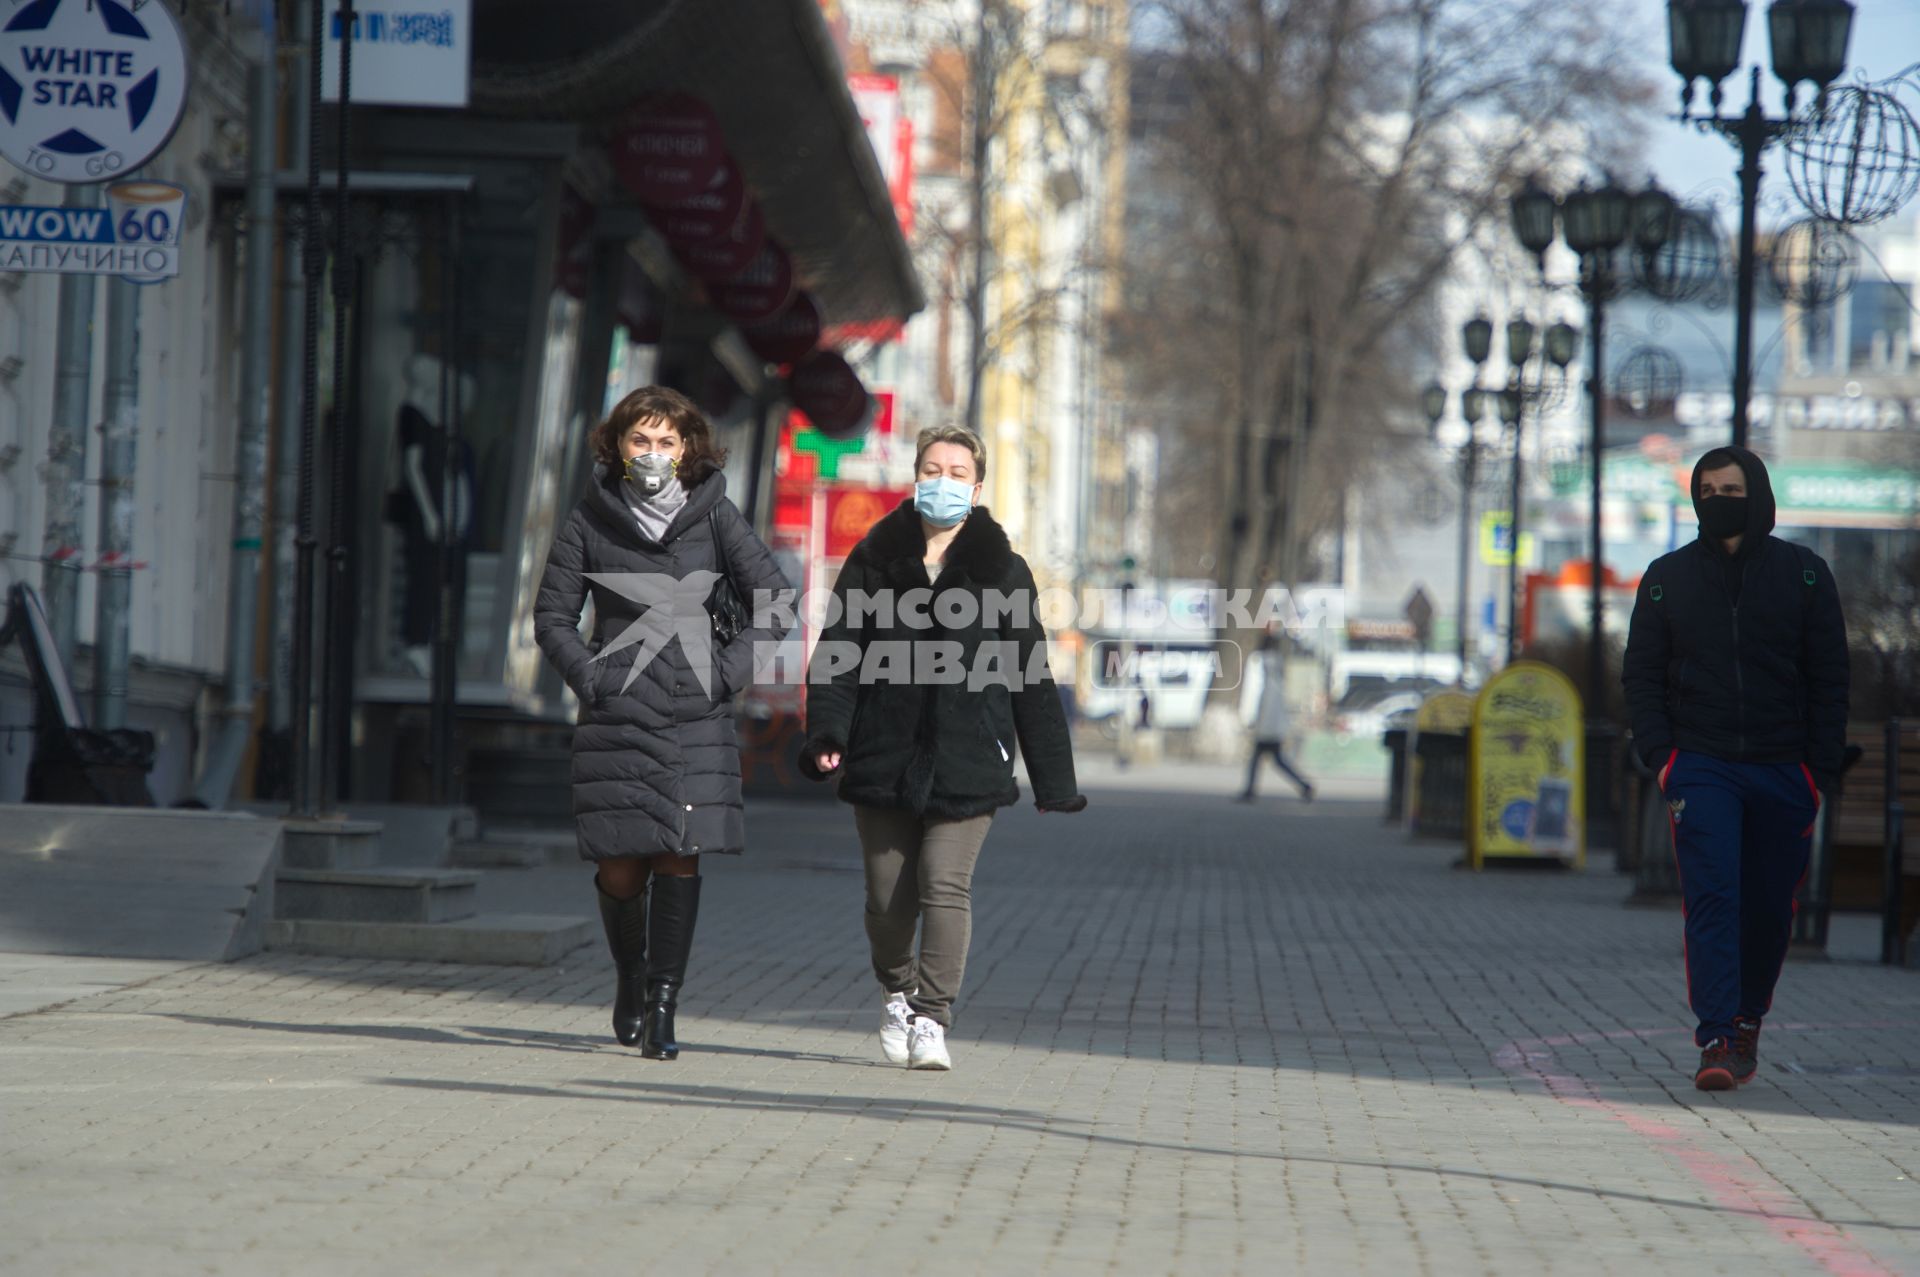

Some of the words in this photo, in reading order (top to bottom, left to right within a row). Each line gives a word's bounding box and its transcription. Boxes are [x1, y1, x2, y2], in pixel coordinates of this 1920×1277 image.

[20, 46, 134, 77] WHITE
[33, 79, 118, 109] STAR
[26, 148, 55, 173] TO
[85, 150, 123, 176] GO
[1, 208, 103, 240] WOW
